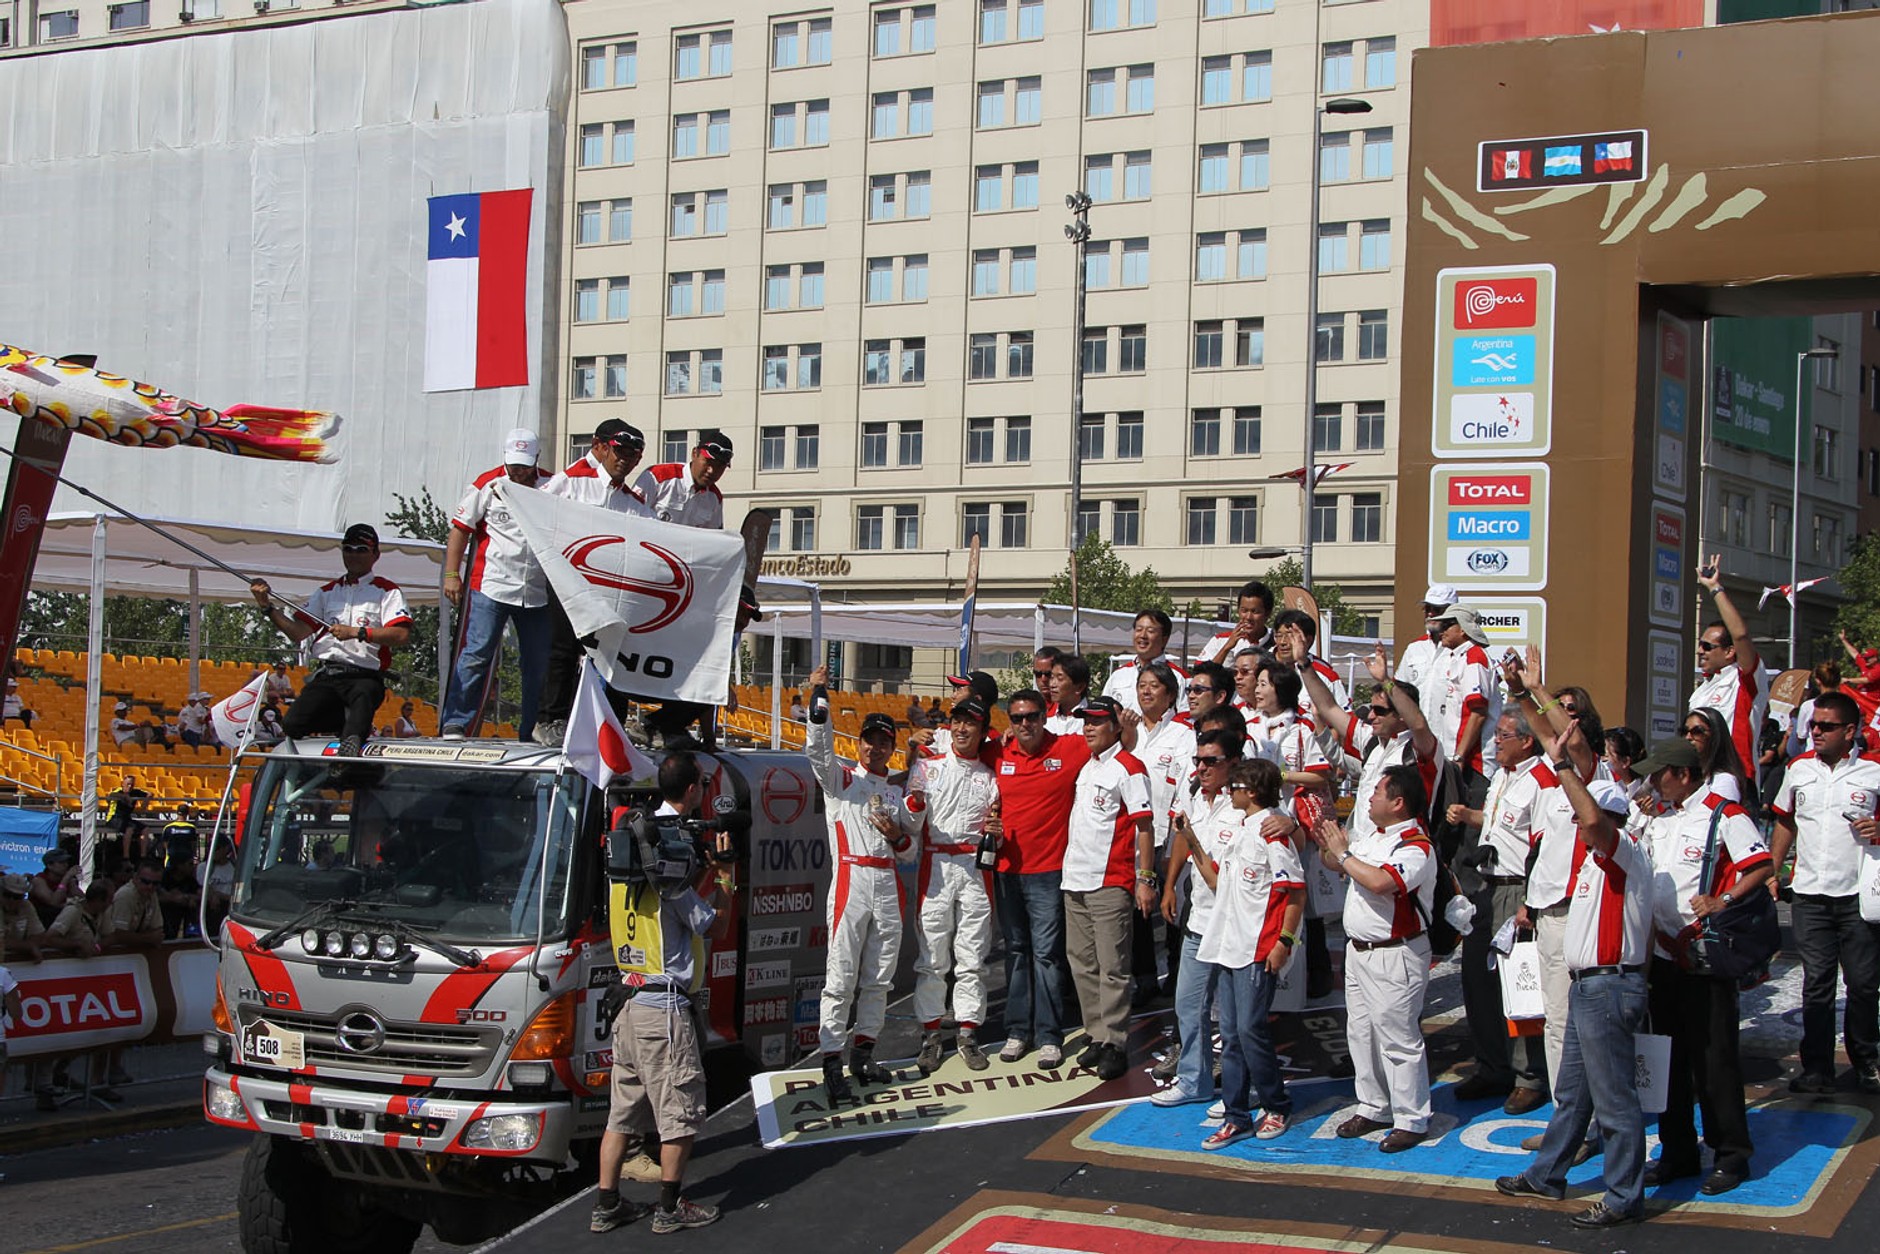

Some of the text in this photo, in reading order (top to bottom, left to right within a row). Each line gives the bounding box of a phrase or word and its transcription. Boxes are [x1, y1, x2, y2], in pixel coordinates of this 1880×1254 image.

[1465, 285, 1525, 323] Perú
[1471, 339, 1514, 351] Argentina
[1462, 422, 1509, 439] Chile
[1454, 482, 1525, 498] TOTAL
[1457, 516, 1520, 534] Macro
[1476, 553, 1499, 565] FOX
[1480, 615, 1520, 627] RCHER
[437, 749, 454, 757] CHILE
[462, 750, 502, 758] dakar.com
[758, 839, 826, 871] TOKYO
[626, 912, 636, 941] 9
[239, 987, 290, 1005] HINO
[5, 988, 137, 1030] OTAL
[456, 1008, 507, 1022] 500
[260, 1038, 279, 1055] 508
[790, 1063, 1102, 1115] ARGENTINA
[794, 1103, 948, 1133] CHILE
